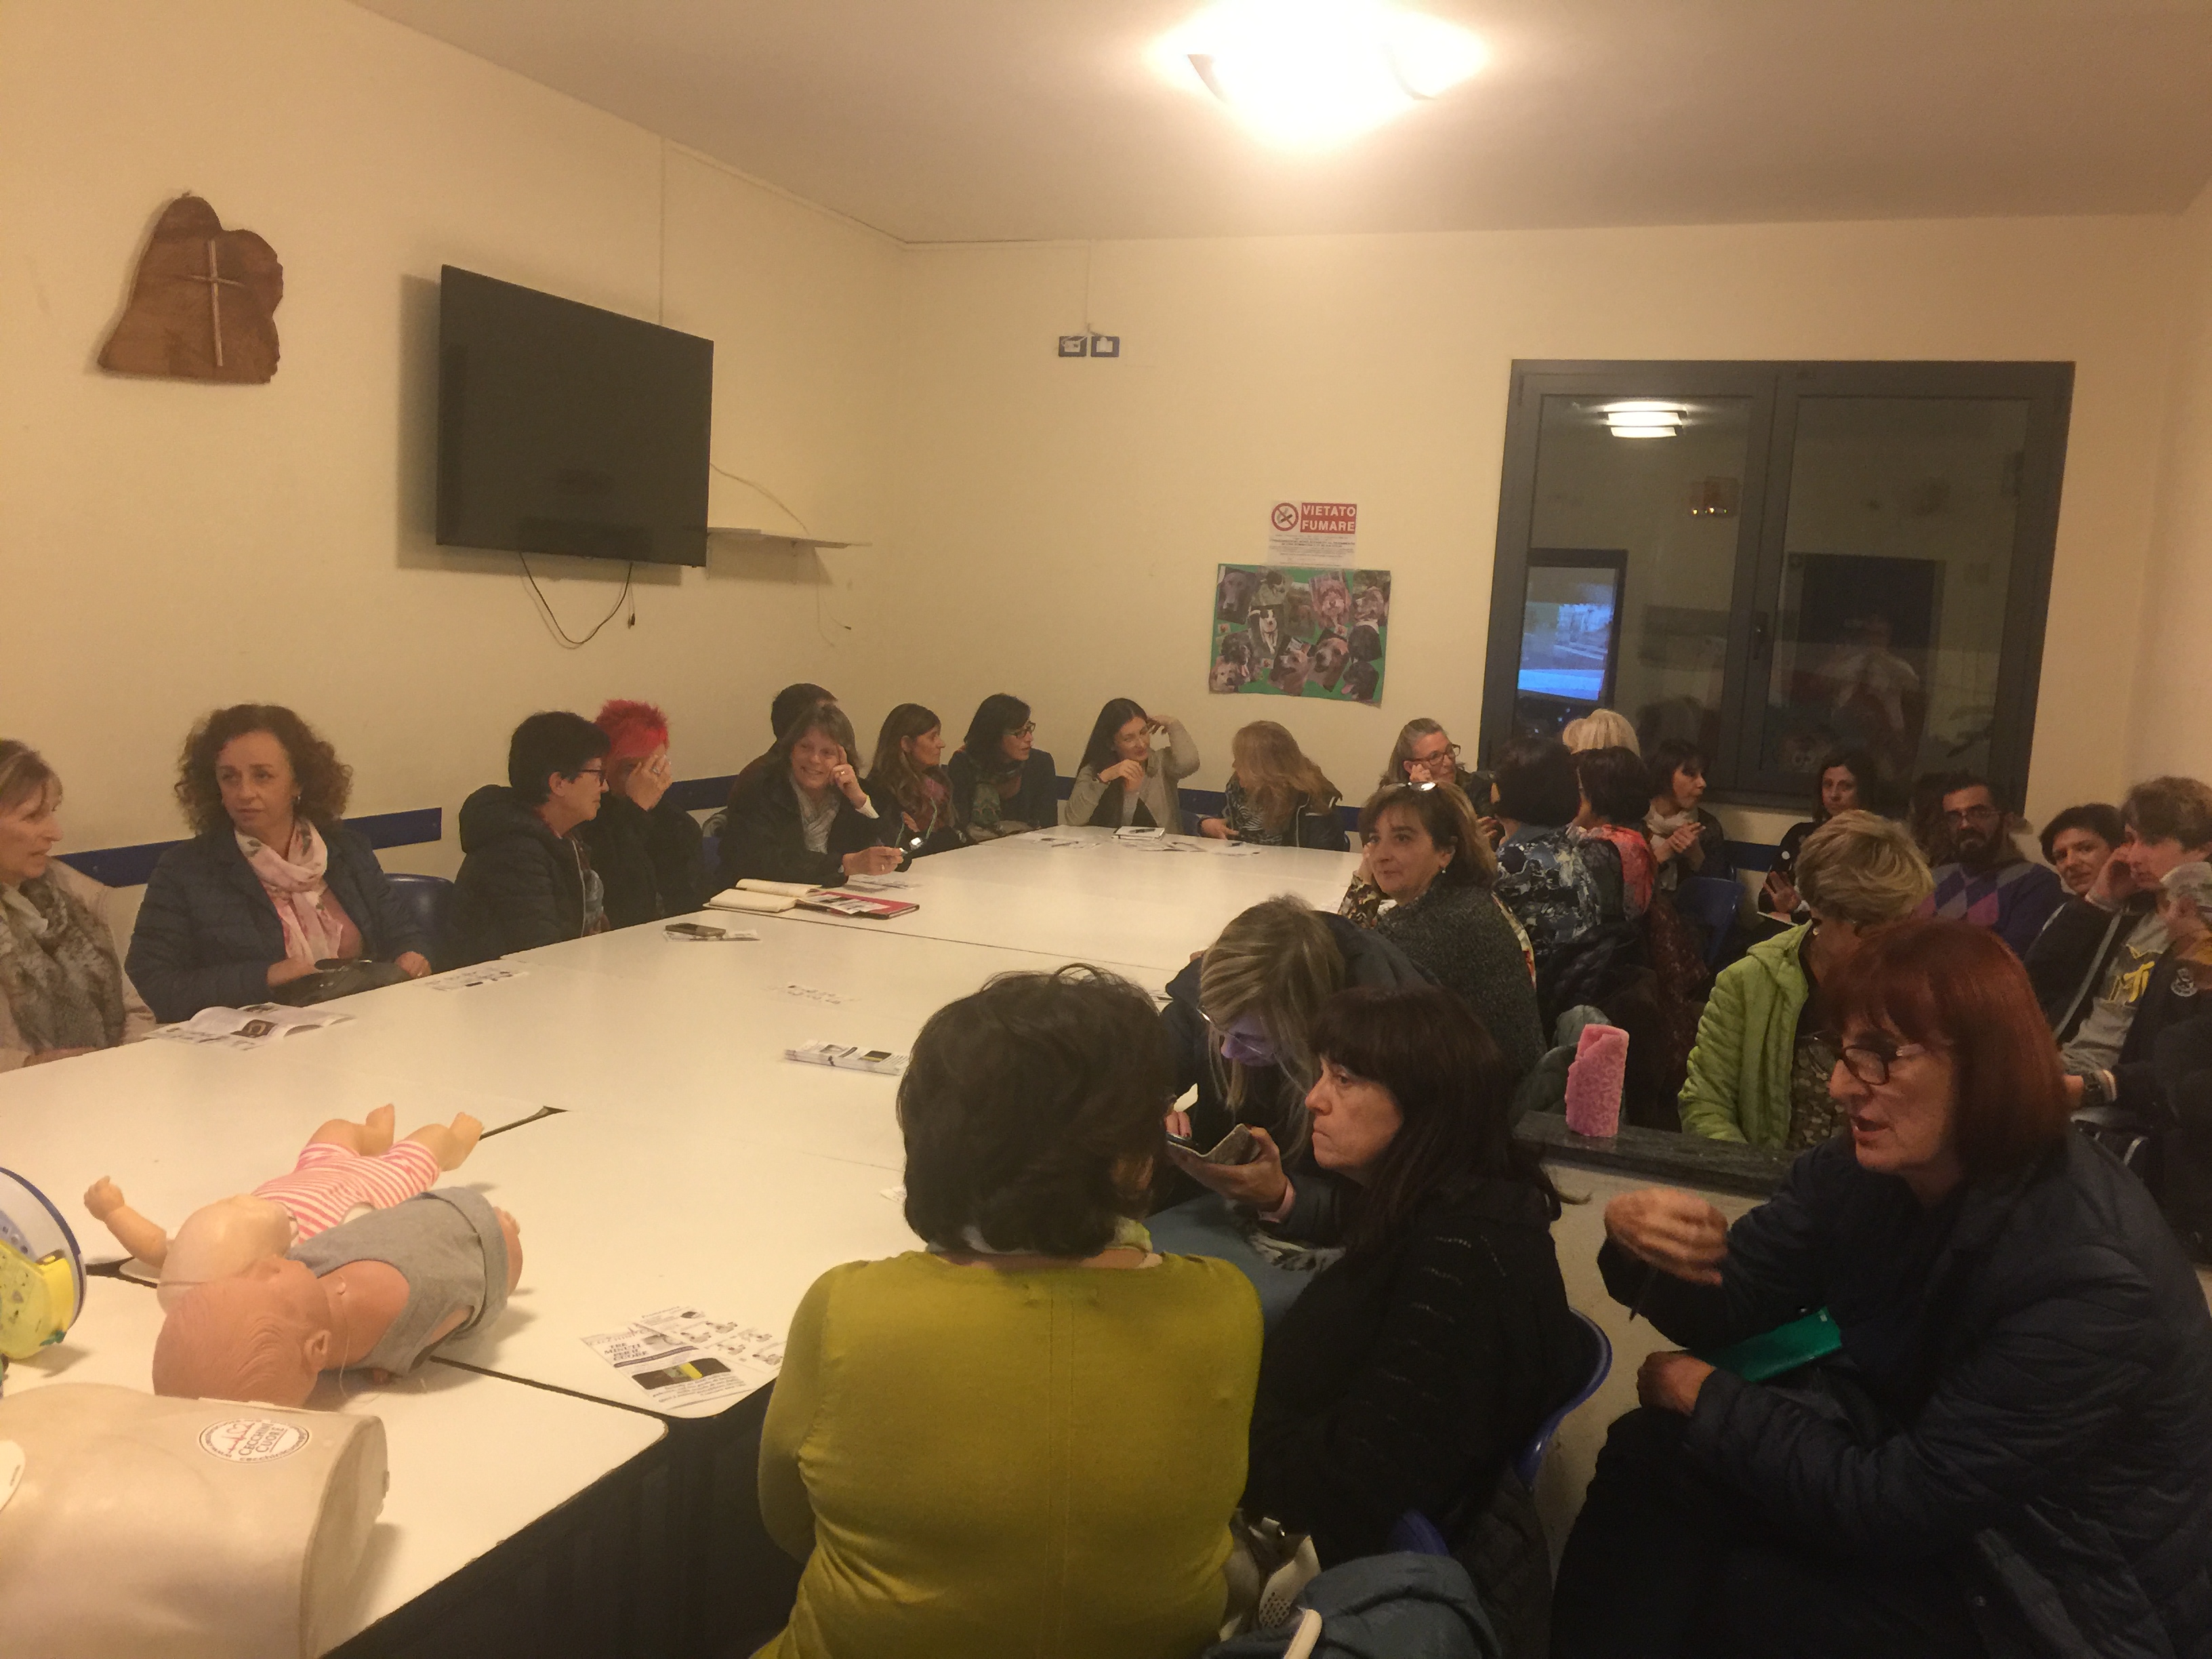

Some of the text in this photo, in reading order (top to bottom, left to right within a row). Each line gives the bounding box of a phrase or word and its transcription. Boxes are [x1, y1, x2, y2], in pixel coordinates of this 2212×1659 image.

[1303, 505, 1356, 517] VIETATO
[1301, 520, 1355, 531] FUMARE
[255, 1427, 285, 1453] CUORE
